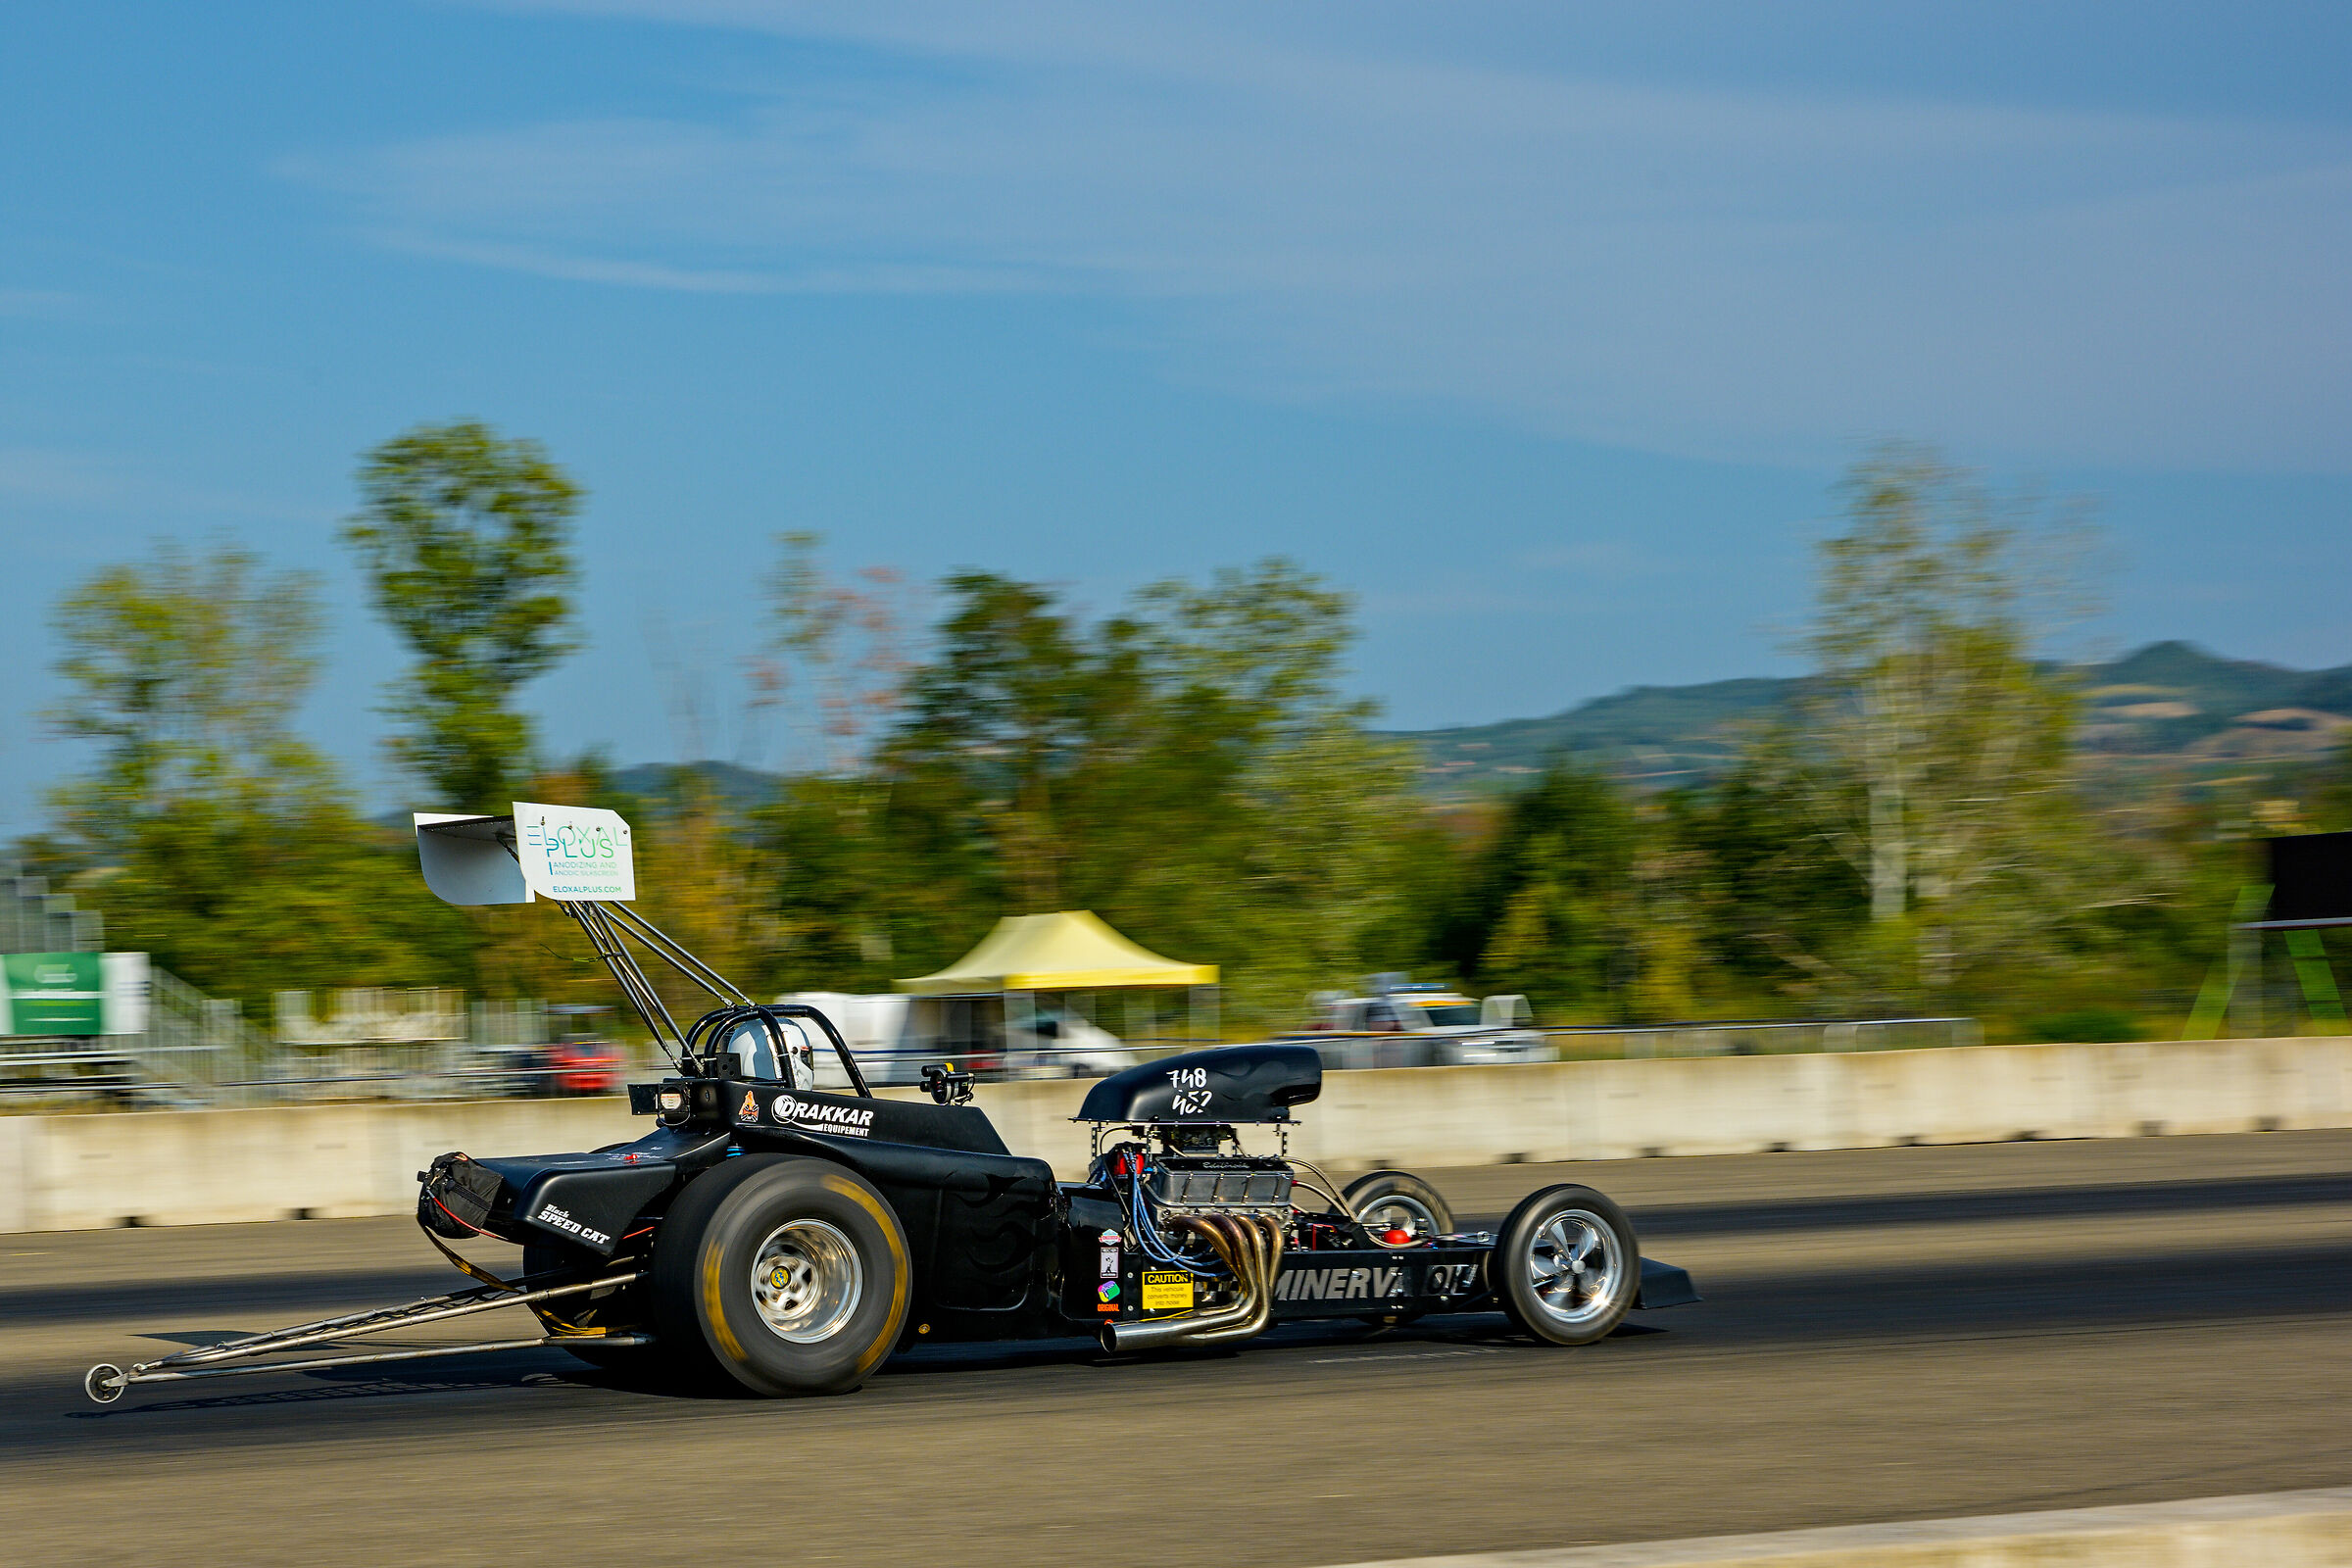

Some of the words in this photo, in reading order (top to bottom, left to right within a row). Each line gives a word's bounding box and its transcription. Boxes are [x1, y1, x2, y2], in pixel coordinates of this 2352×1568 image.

[526, 826, 628, 846] ELOXAL
[547, 838, 614, 858] PLUS
[1166, 1067, 1207, 1089] 748
[779, 1100, 874, 1126] DRAKKAR
[823, 1123, 869, 1137] EQUIPEMENT
[544, 1203, 569, 1218] Black
[537, 1210, 582, 1234] SPEED
[580, 1227, 612, 1245] CAT
[1147, 1273, 1189, 1284] CAUTION
